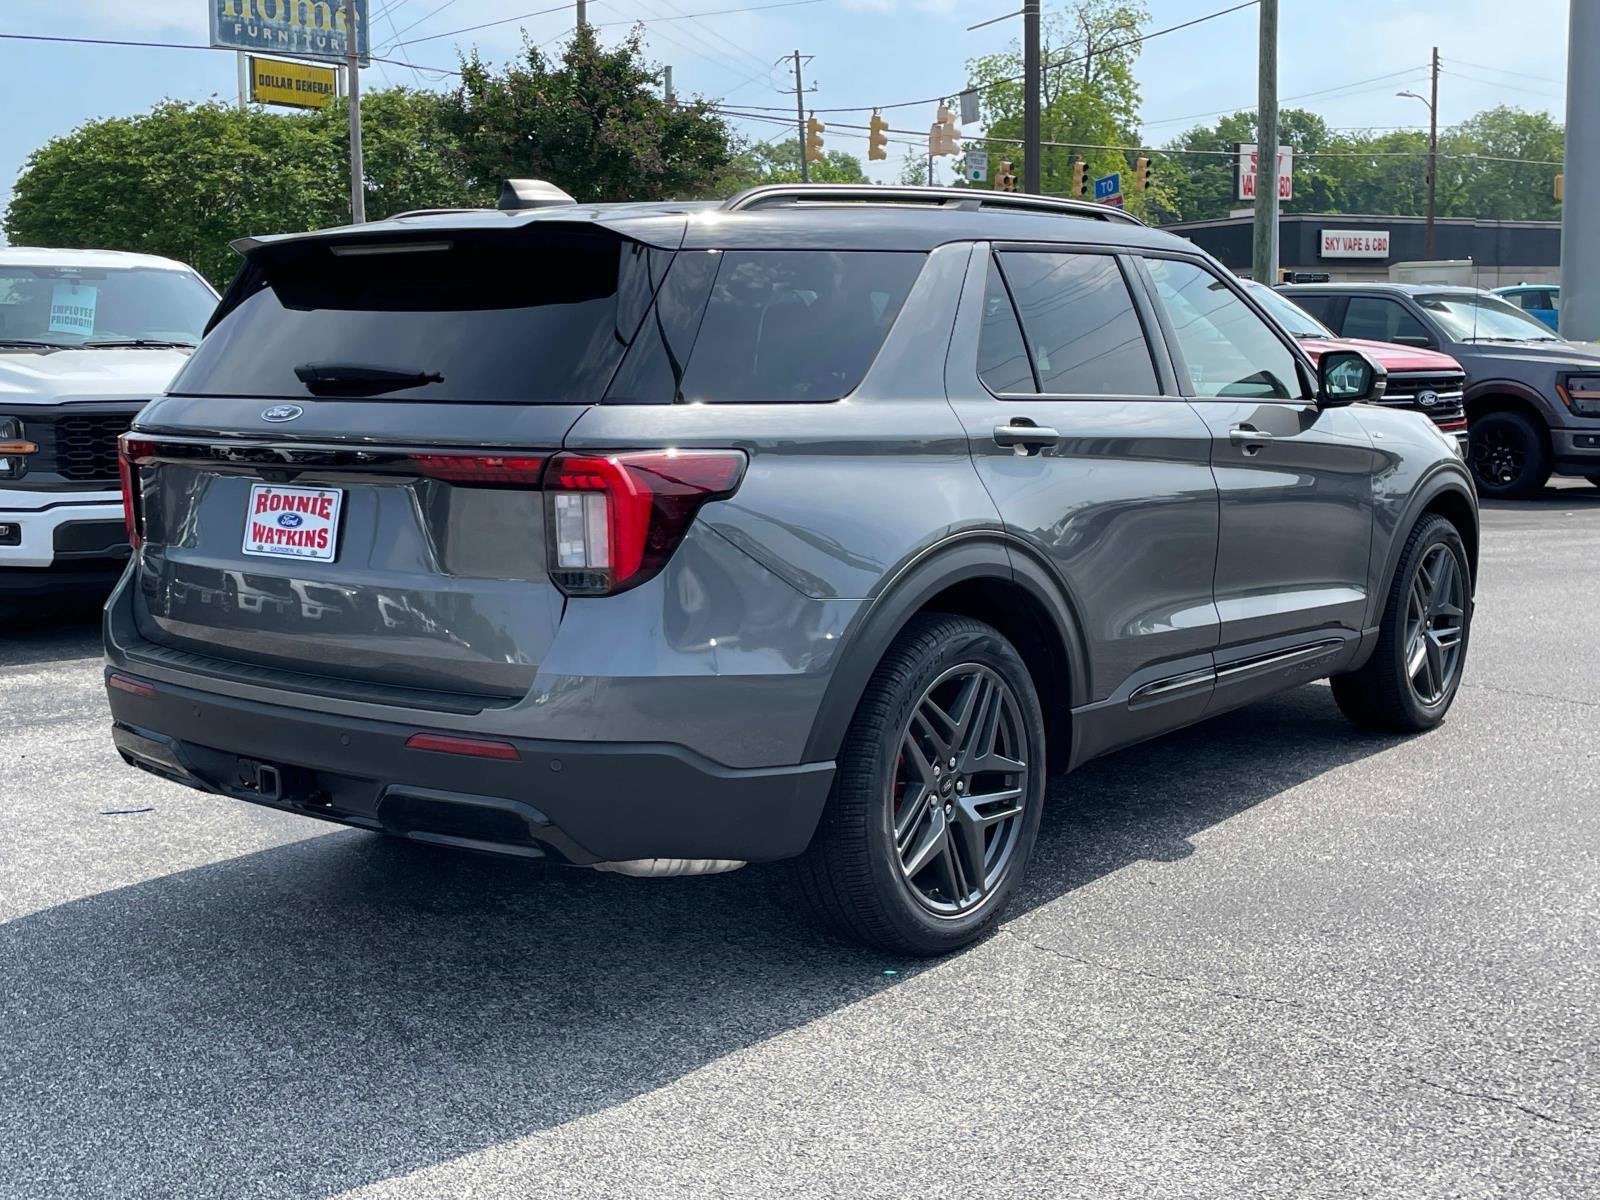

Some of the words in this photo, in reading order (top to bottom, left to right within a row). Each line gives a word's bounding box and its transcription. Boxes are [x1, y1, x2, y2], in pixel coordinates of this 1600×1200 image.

[258, 74, 293, 90] DOLLAR
[295, 79, 333, 95] GENERAL
[1250, 152, 1284, 174] SY
[1100, 180, 1114, 194] TO
[1279, 176, 1291, 198] BD
[1324, 236, 1340, 250] SKY
[1343, 237, 1363, 251] VAPE
[1364, 238, 1370, 251] &
[1372, 238, 1388, 251] CBD
[52, 304, 94, 318] EMPLOYEE
[255, 493, 334, 521] RONNIE
[279, 513, 300, 526] Ford
[252, 521, 329, 550] WATKINS
